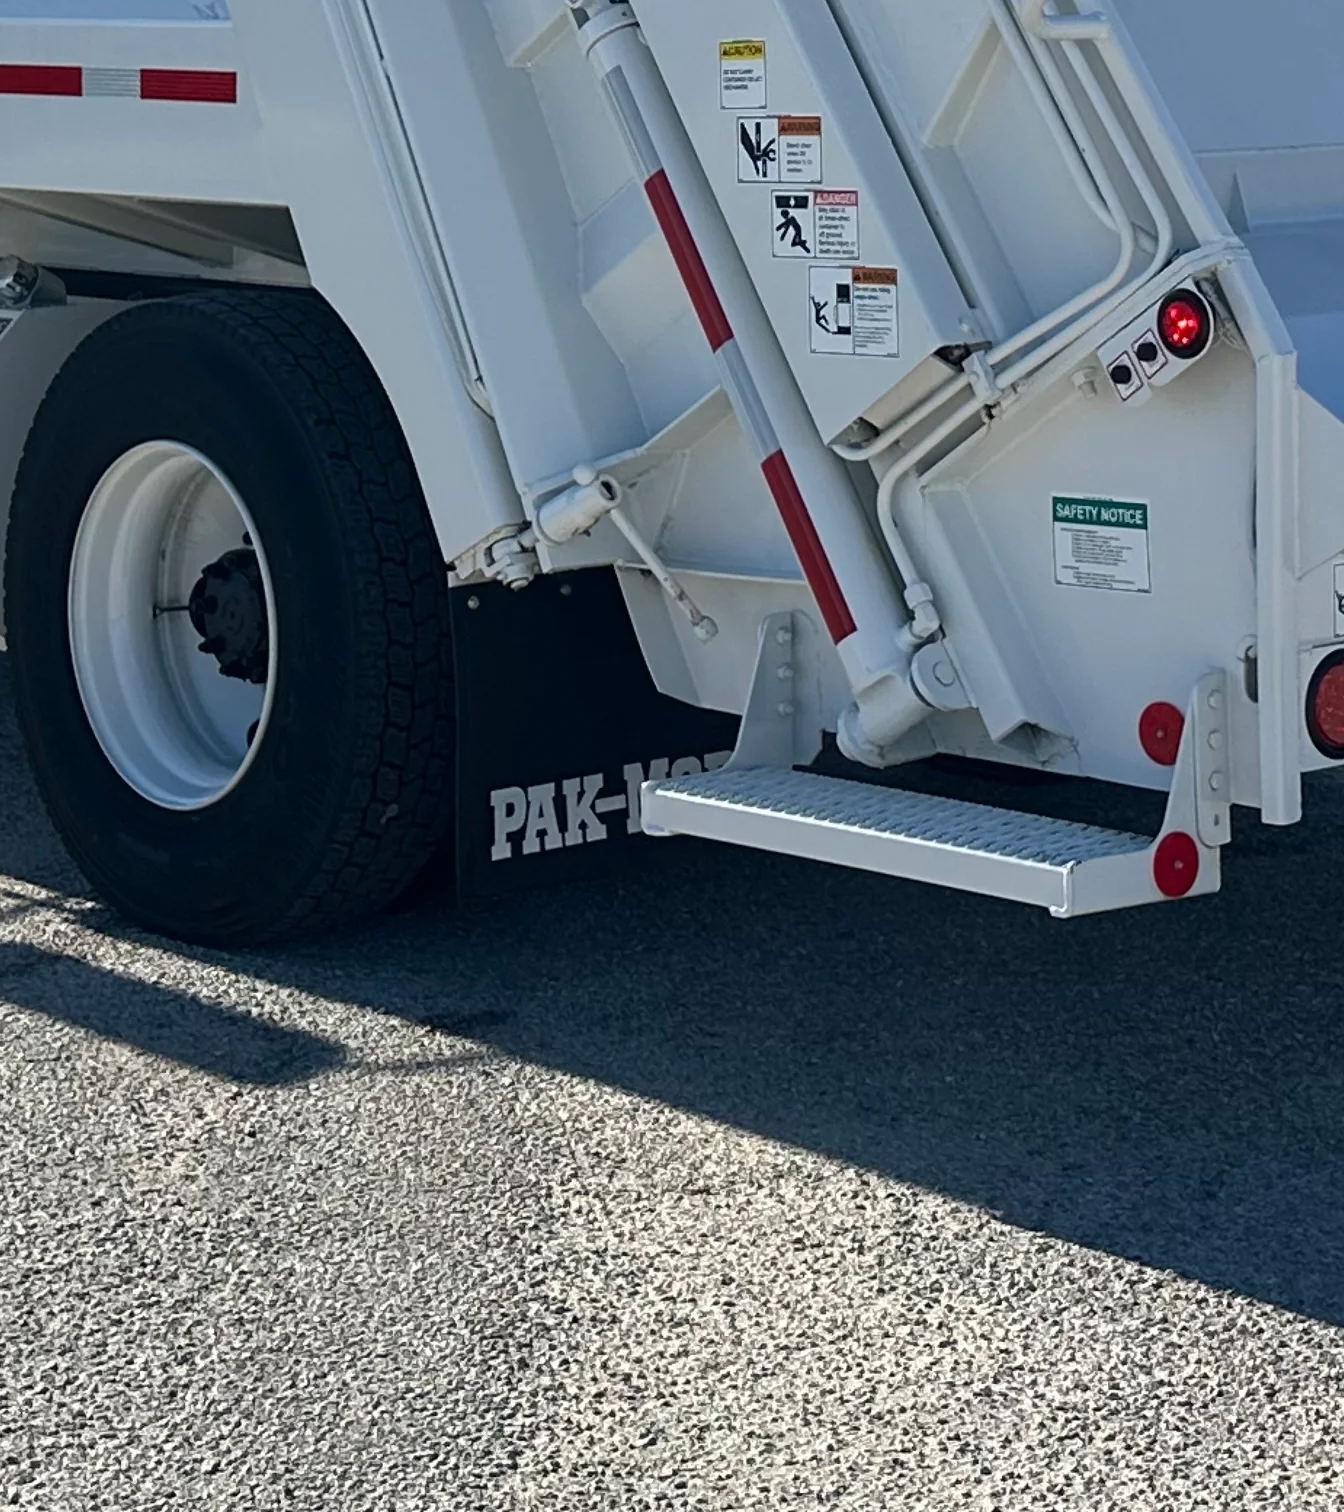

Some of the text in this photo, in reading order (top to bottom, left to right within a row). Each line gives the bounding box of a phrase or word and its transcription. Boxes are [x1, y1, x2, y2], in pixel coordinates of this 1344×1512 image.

[1056, 502, 1144, 525] SAFETY NOTICE
[490, 750, 735, 861] PAK-M
